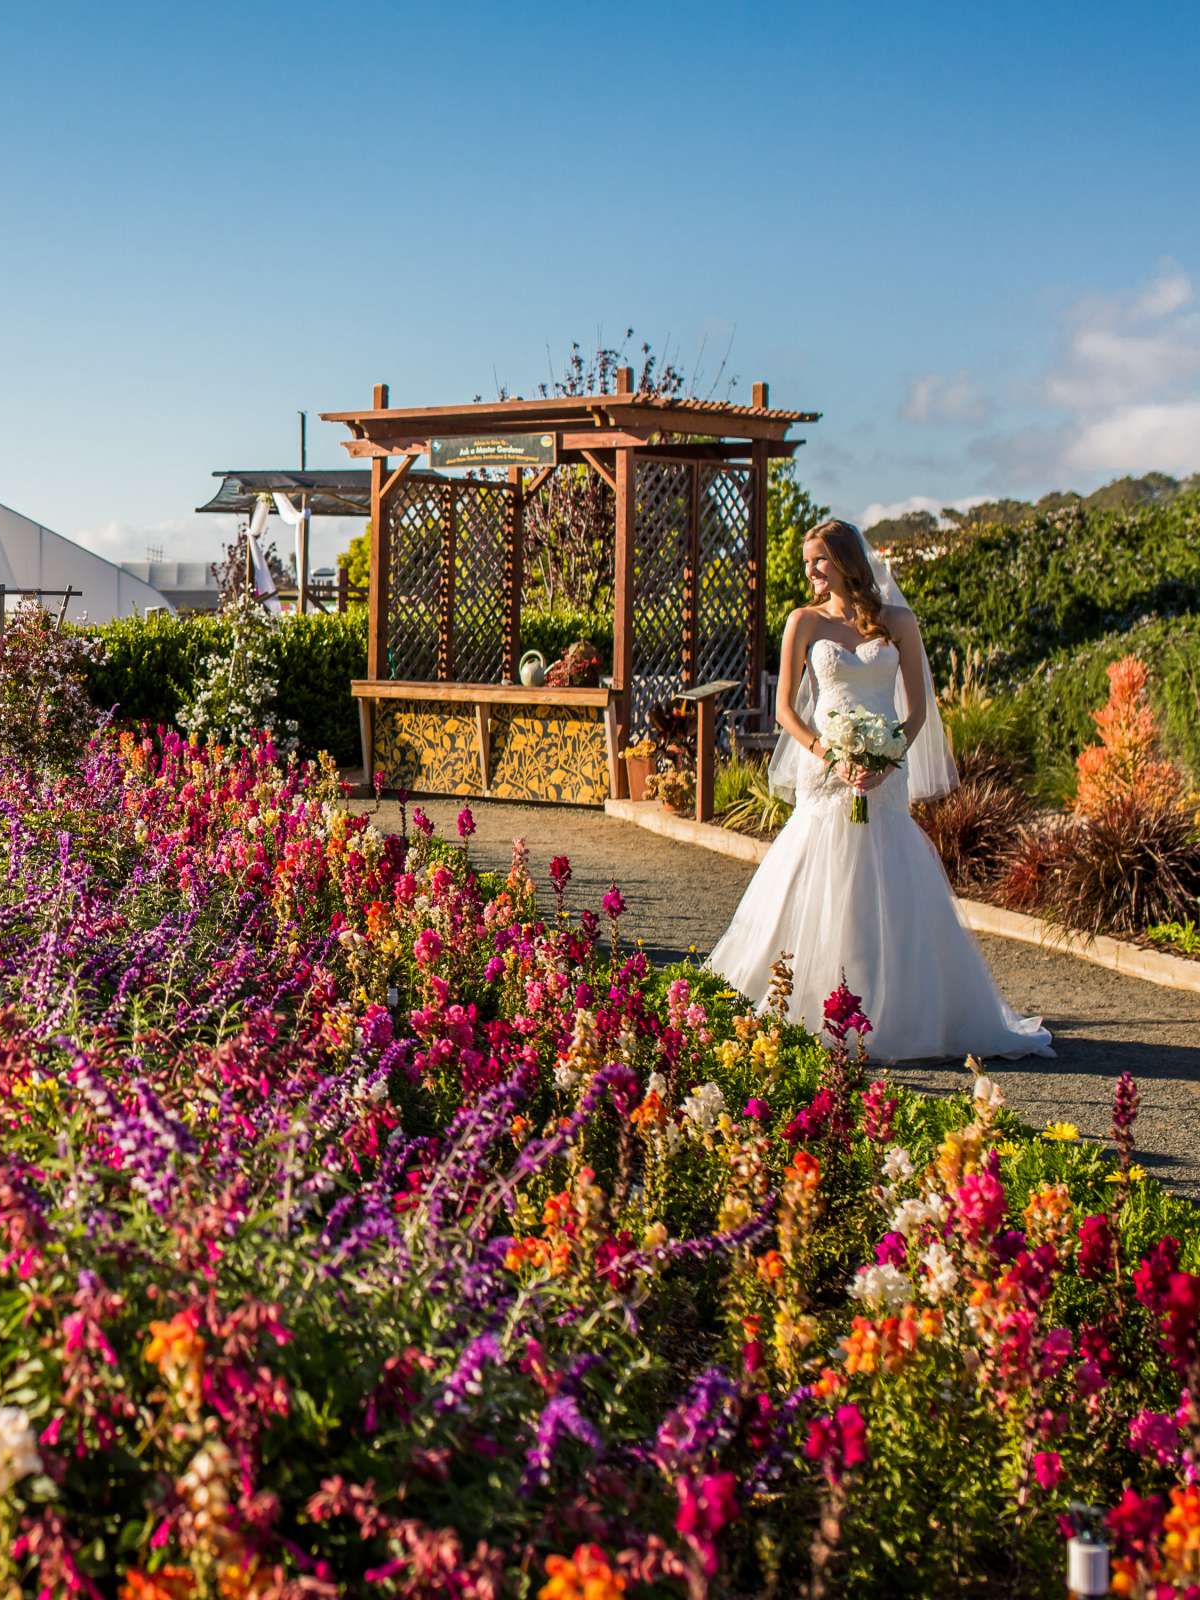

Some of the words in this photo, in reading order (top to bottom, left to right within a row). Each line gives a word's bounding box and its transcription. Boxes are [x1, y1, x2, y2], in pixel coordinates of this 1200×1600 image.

[459, 447, 469, 457] Ask
[475, 446, 496, 454] Master
[496, 445, 525, 455] Gardener
